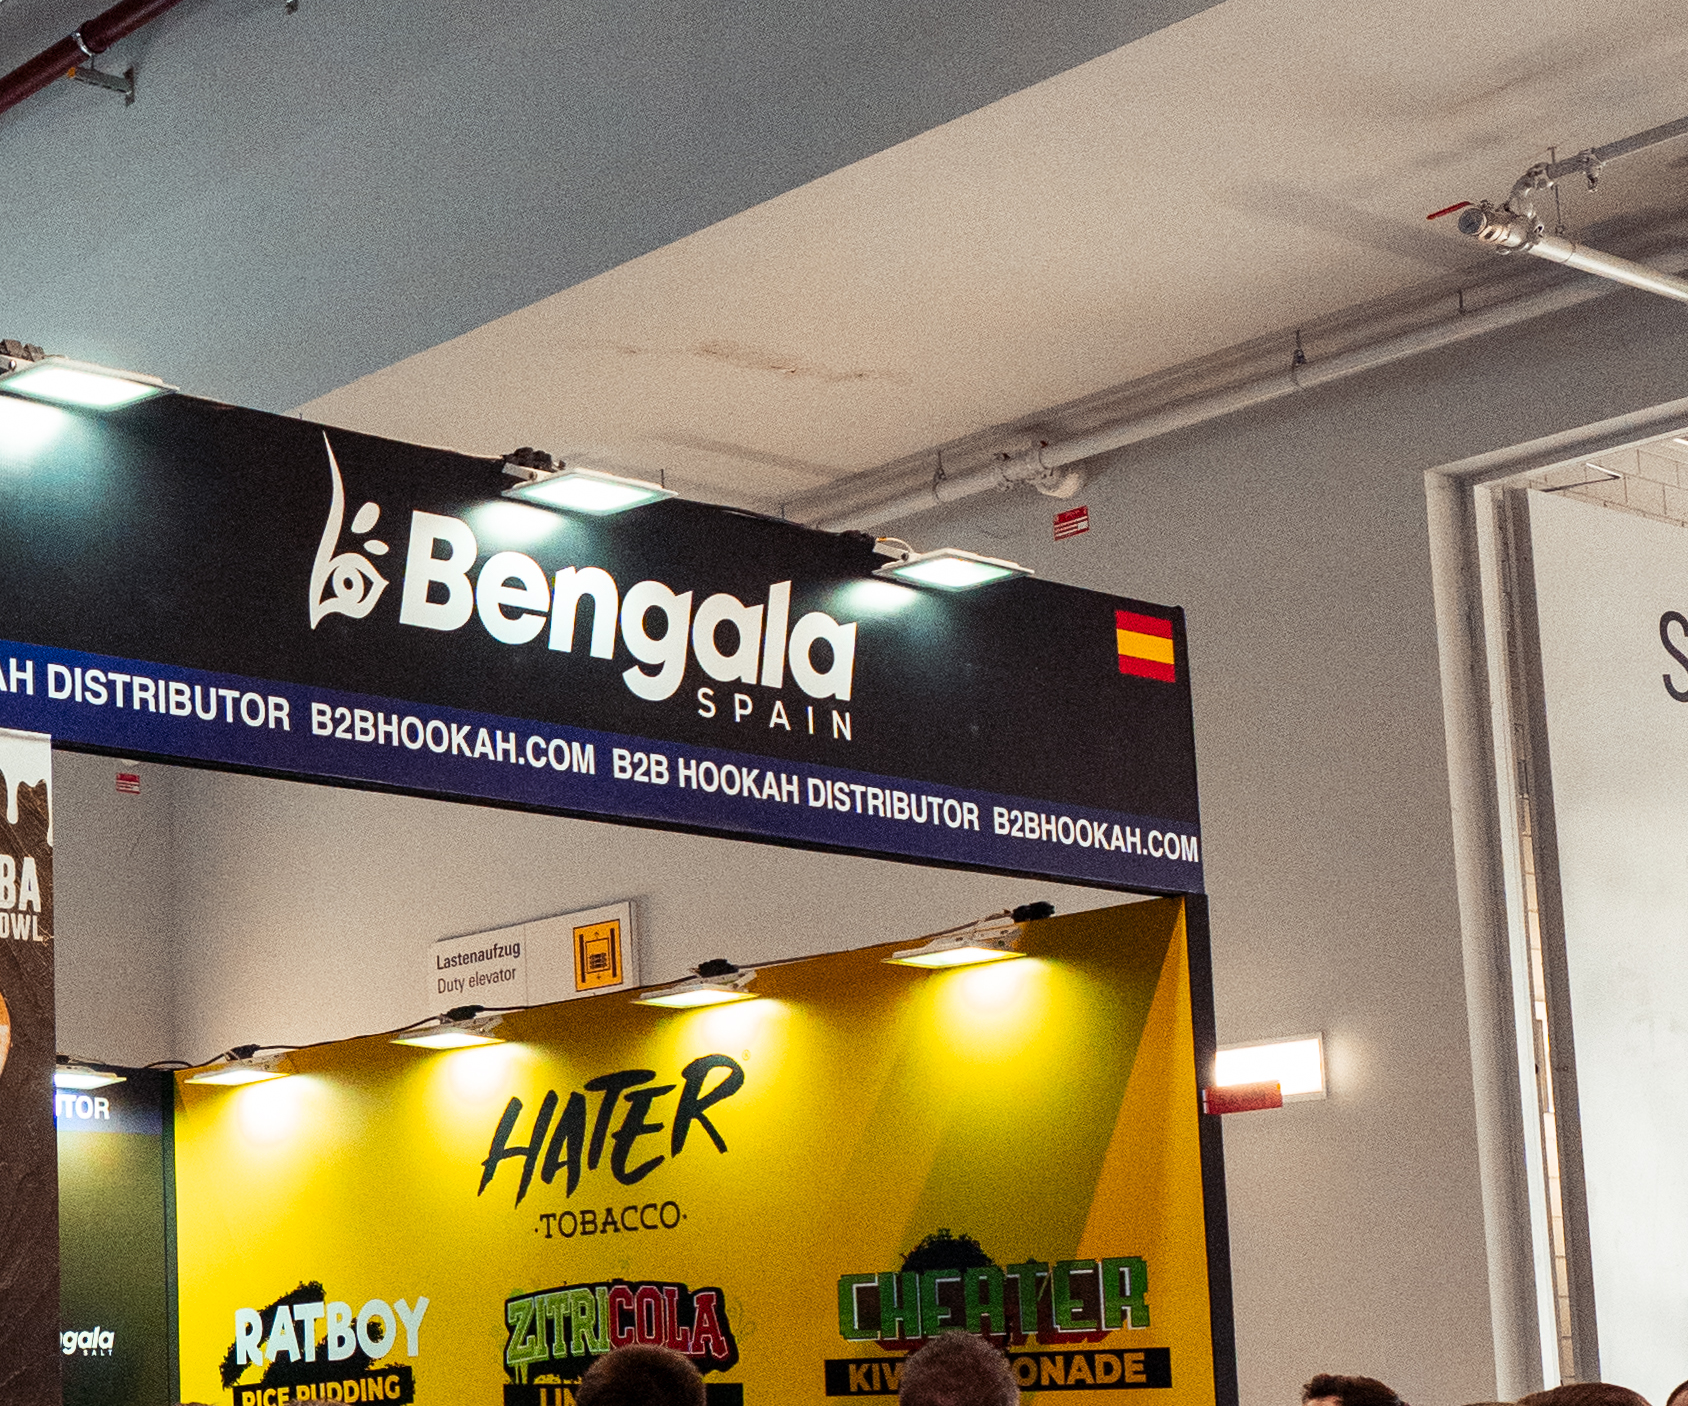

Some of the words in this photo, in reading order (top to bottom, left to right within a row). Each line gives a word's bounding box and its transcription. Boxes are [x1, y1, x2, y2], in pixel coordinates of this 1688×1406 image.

[400, 509, 858, 701] Bengala
[697, 686, 853, 741] SPAIN
[47, 663, 289, 731] DISTRIBUTOR
[312, 702, 596, 775] B2BHOOKAH.COM
[612, 747, 670, 786] B2B
[678, 757, 800, 805] HOOKAH
[807, 777, 980, 833] DISTRIBUTOR
[993, 806, 1198, 864] B2BHOOKAH.COM
[436, 942, 521, 970] Lastenaufzug
[437, 977, 464, 994] Duty
[468, 968, 516, 988] elevator
[477, 1053, 745, 1210] HATER
[235, 1296, 430, 1366] RATBOY
[506, 1285, 729, 1365] ZITRICOLA
[838, 1255, 1150, 1342] CHEATER
[83, 1349, 113, 1357] SALT
[296, 1374, 400, 1403] PUDDING
